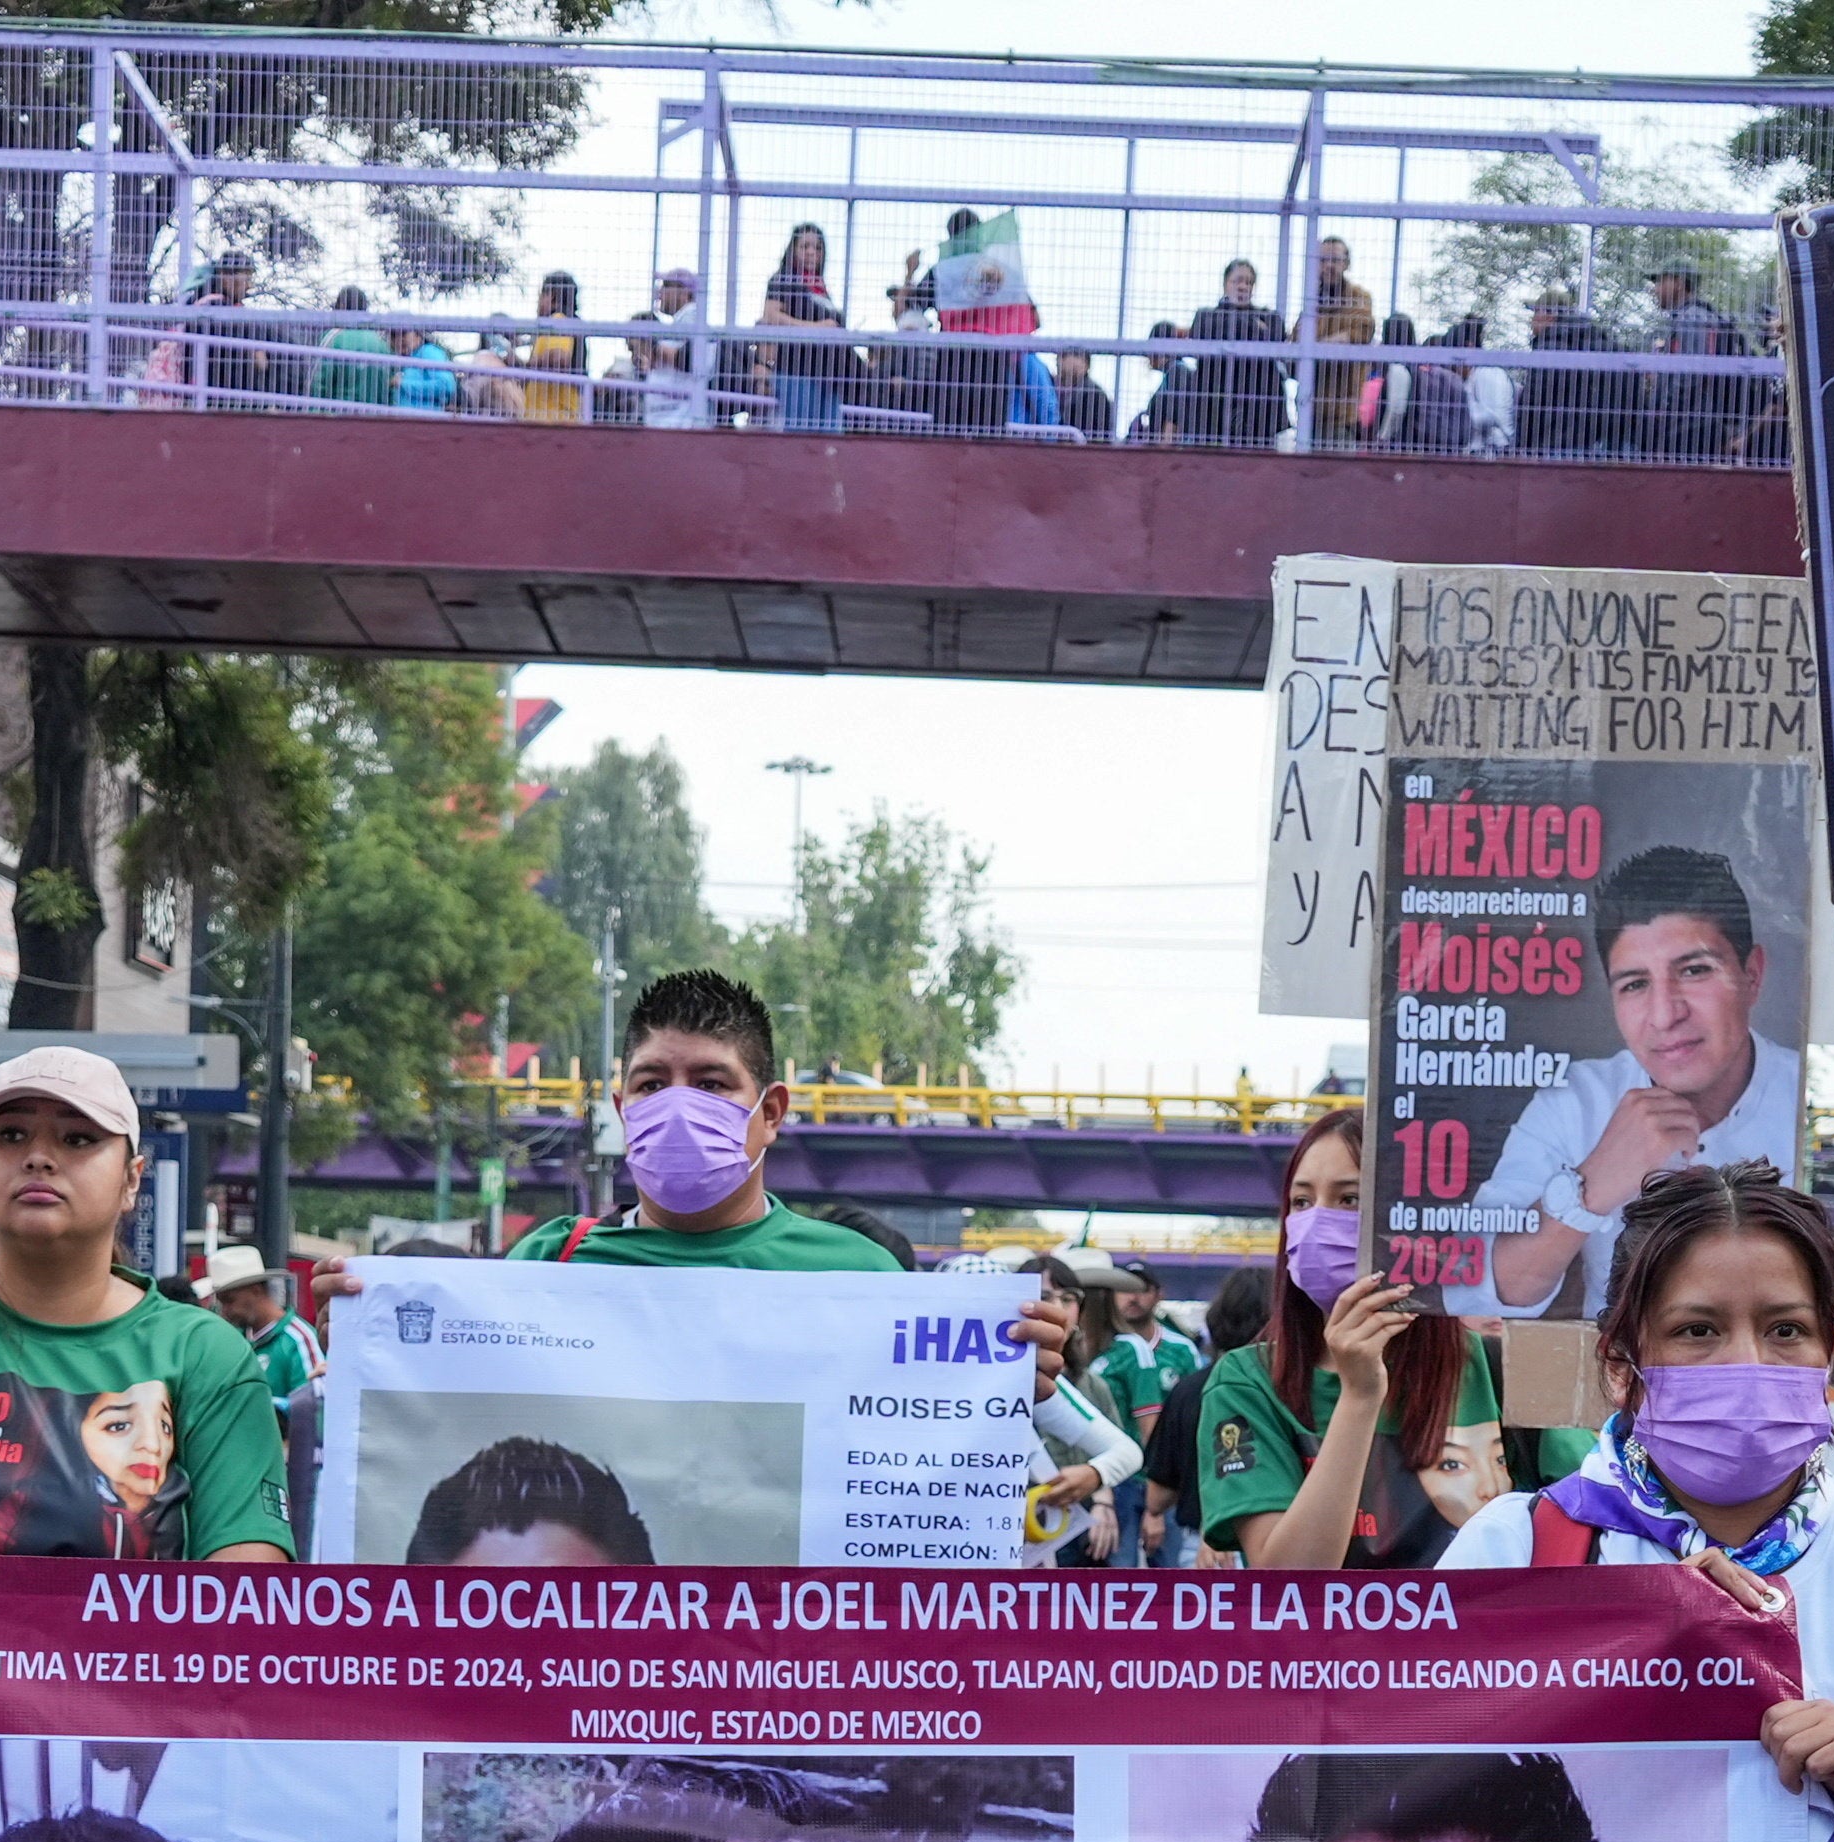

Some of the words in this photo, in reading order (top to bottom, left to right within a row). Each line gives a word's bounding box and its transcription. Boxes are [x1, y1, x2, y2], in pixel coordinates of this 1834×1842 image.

[1397, 576, 1494, 649] HAS
[1508, 587, 1677, 652] ANYONE
[1696, 592, 1812, 655] SEEN
[1392, 642, 1559, 692] MOISES?
[1571, 648, 1634, 691] HIS
[1643, 651, 1772, 697] FAMILY
[1785, 657, 1817, 697] IS
[1390, 692, 1589, 750] WAITING
[1609, 698, 1685, 752] FOR
[1701, 699, 1813, 753] HIM.
[1404, 773, 1433, 799] en
[1402, 789, 1602, 880] MÉXICO
[1401, 885, 1569, 917] desaparecieron
[1572, 893, 1587, 916] a
[1396, 919, 1583, 995] Moisés
[1396, 996, 1506, 1041] García
[1395, 1042, 1570, 1087] Hernández
[1394, 1091, 1414, 1120] el
[1393, 1119, 1469, 1198] 10
[1389, 1203, 1414, 1231] de
[1420, 1204, 1540, 1233] noviembre
[1388, 1236, 1485, 1287] 2023
[441, 1333, 501, 1344] ESTADO
[507, 1334, 527, 1345] DE
[532, 1335, 595, 1349] MÉXICO
[845, 1513, 970, 1531] ESTATURA:
[845, 1541, 997, 1562] COMPLEXIÓN:
[82, 1573, 372, 1627] AYUDANOS
[384, 1578, 419, 1628] A
[434, 1578, 709, 1631] LOCALIZAR
[723, 1582, 760, 1631] A
[773, 1582, 887, 1631] JOEL
[902, 1582, 1157, 1631] MARTINEZ
[1172, 1582, 1235, 1632] DE
[1251, 1582, 1311, 1632] LA
[1324, 1582, 1458, 1632] ROSA
[73, 1650, 128, 1682] VEZ
[134, 1651, 165, 1682] EL
[172, 1650, 201, 1683] 19
[213, 1651, 250, 1684] DE
[259, 1652, 398, 1685] OCTUBRE
[407, 1653, 444, 1686] DE
[452, 1656, 532, 1693] 2024,
[539, 1658, 620, 1690] SALIO
[627, 1658, 665, 1690] DE
[670, 1658, 728, 1690] SAN
[736, 1659, 845, 1691] MIGUEL
[849, 1659, 967, 1696] AJUSCO,
[974, 1659, 1101, 1696] TLALPAN,
[1109, 1659, 1218, 1691] CIUDAD
[1227, 1659, 1262, 1691] DE
[1269, 1659, 1379, 1691] MEXICO
[1387, 1659, 1538, 1691] LLEGANDO
[1543, 1658, 1565, 1690] A
[1571, 1656, 1688, 1692] CHALCO,
[1696, 1656, 1755, 1688] COL.
[571, 1708, 702, 1746] MIXQUIC,
[711, 1709, 820, 1741] ESTADO
[828, 1710, 865, 1742] DE
[871, 1710, 981, 1742] MEXICO
